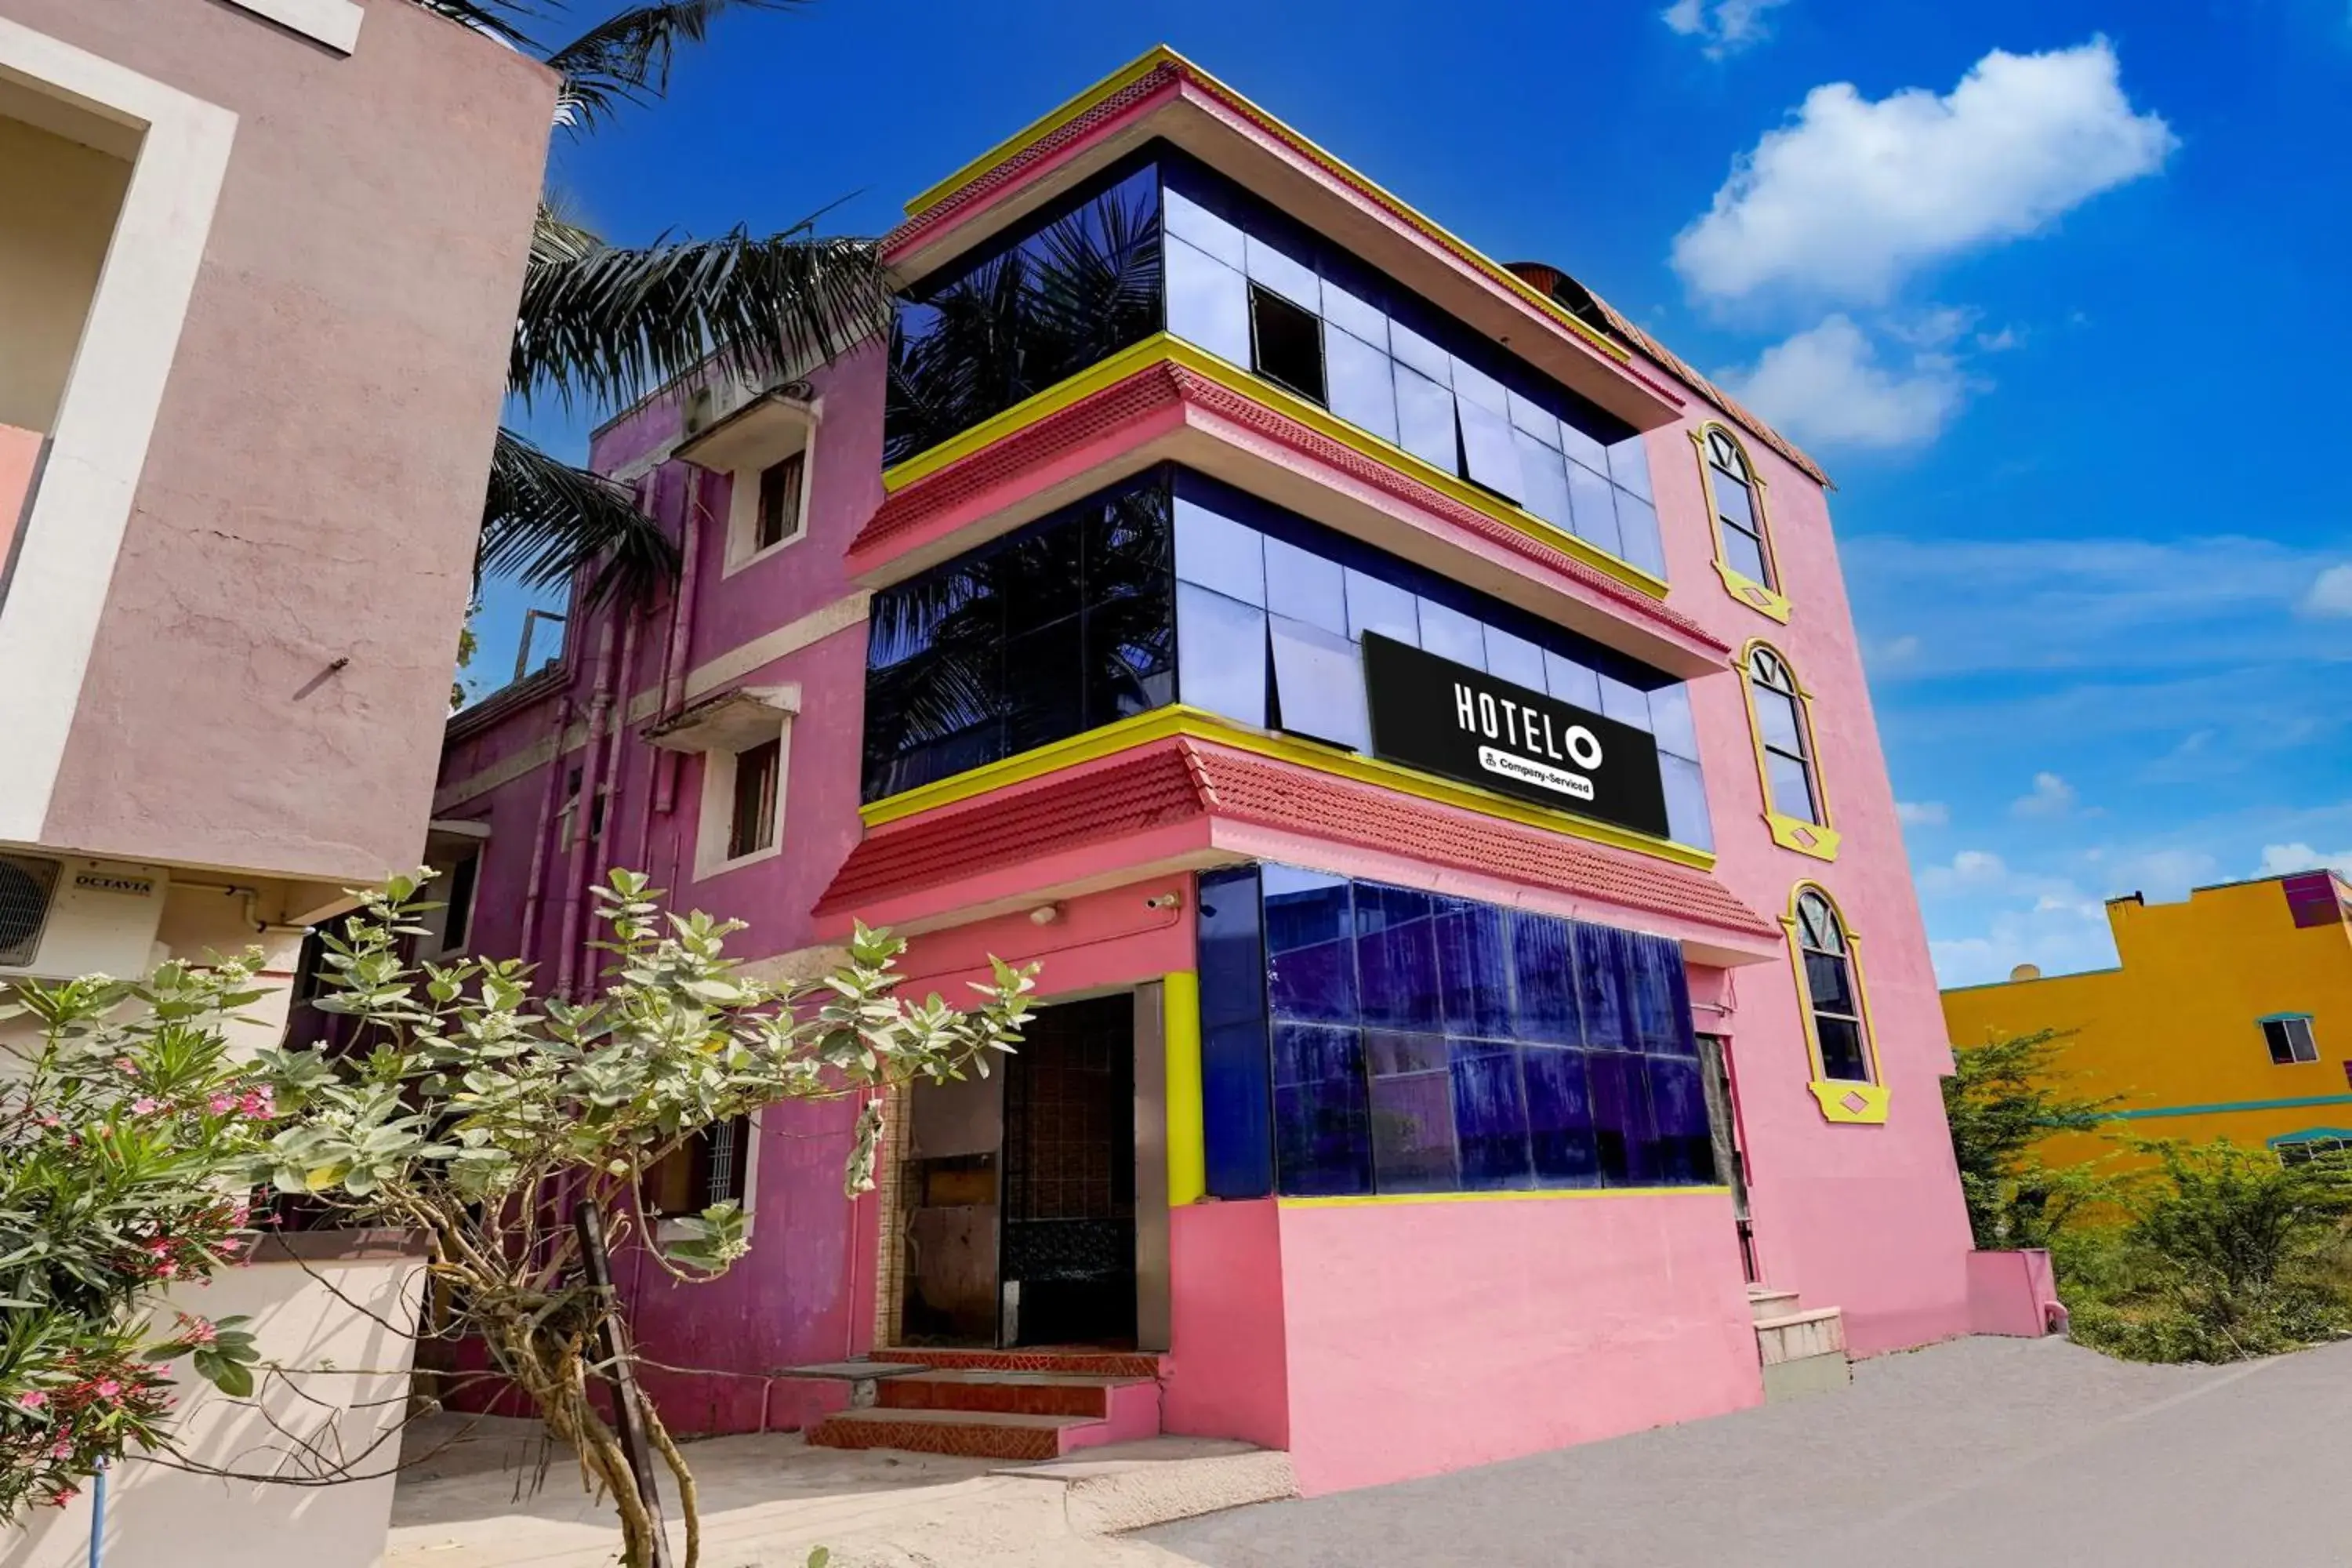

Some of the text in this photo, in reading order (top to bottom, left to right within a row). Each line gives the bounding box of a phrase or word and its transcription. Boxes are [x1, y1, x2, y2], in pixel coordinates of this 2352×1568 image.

[1454, 683, 1563, 760] HOTEL
[1500, 758, 1589, 793] Company-Serviced
[76, 875, 150, 892] OCTAVIA
